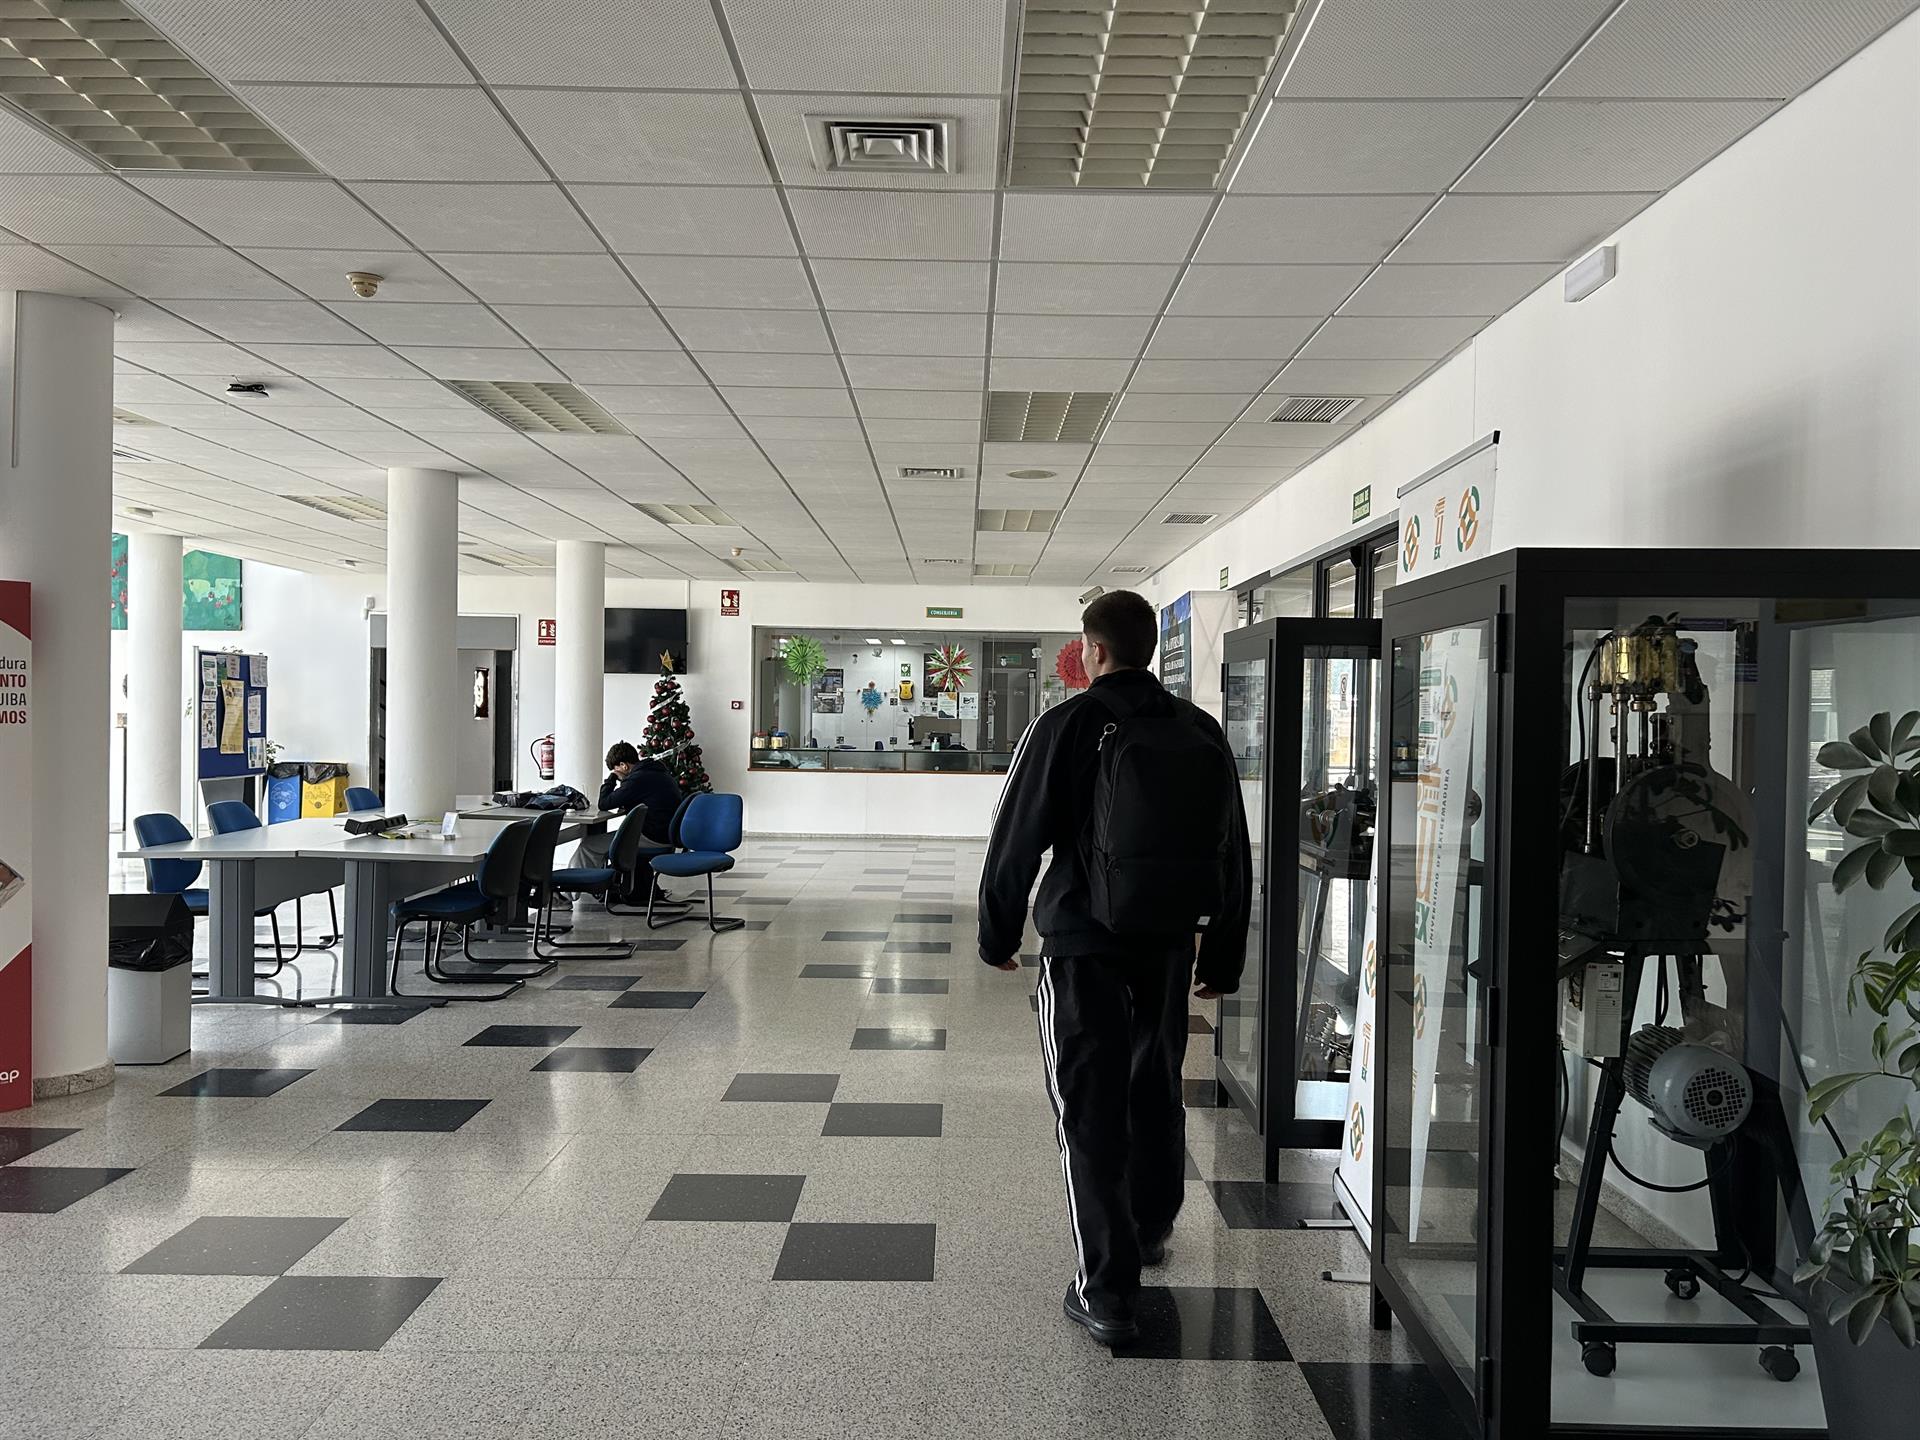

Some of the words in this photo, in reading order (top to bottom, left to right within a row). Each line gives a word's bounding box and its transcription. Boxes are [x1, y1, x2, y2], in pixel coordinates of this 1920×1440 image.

[0, 656, 27, 670] dura
[0, 674, 27, 688] NTO
[0, 710, 27, 724] MOS
[1438, 768, 1451, 849] EXTREMADURA
